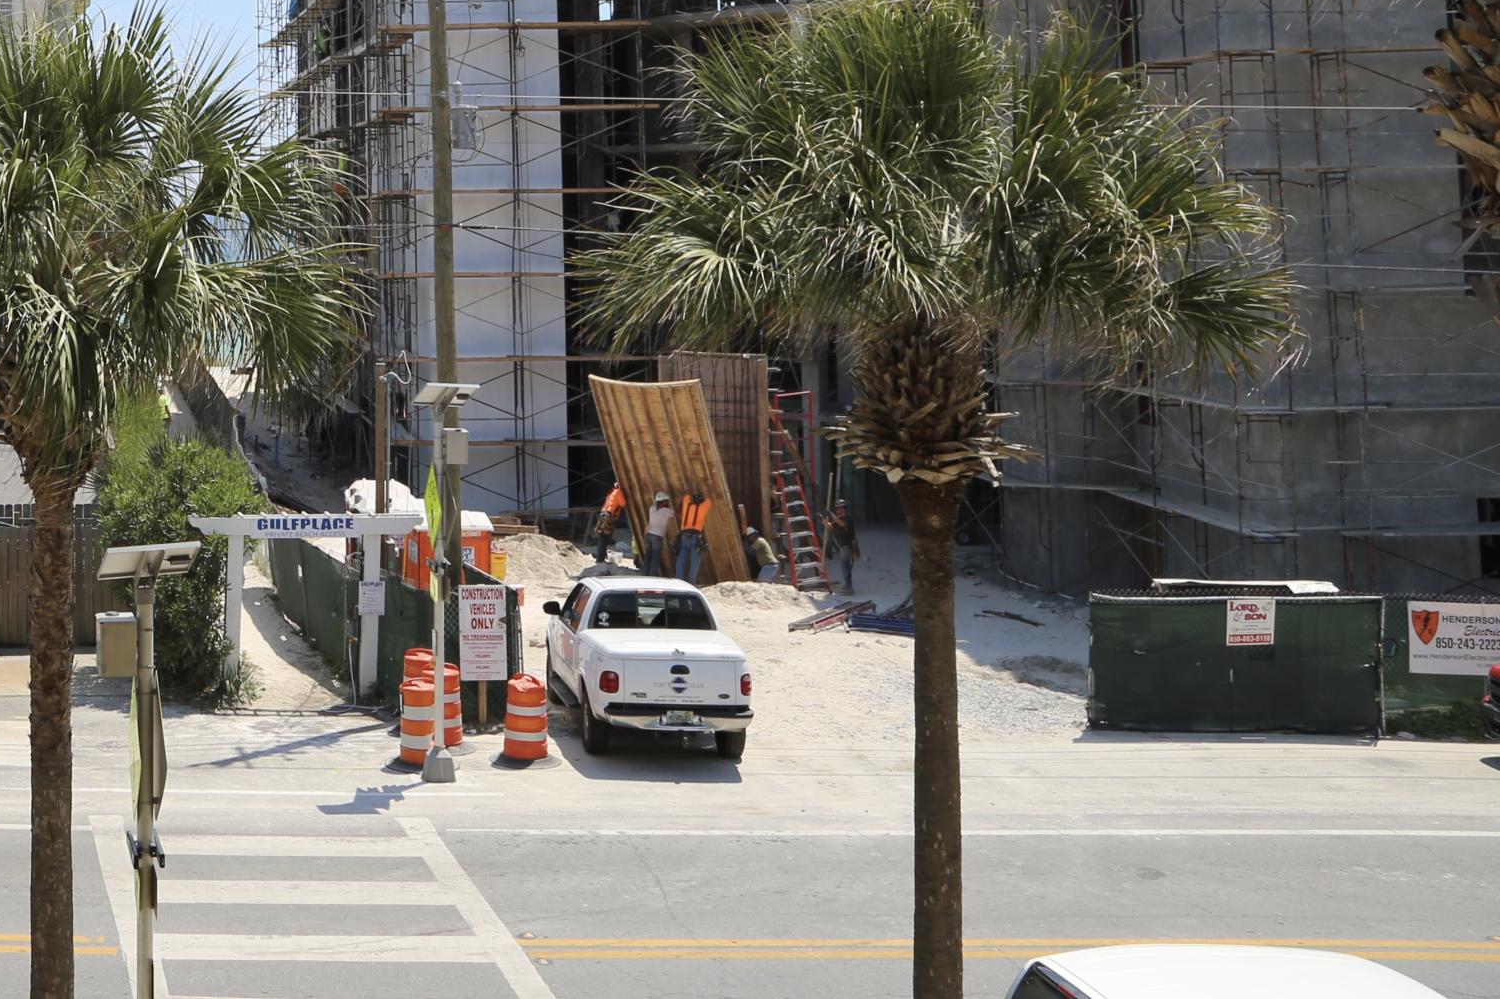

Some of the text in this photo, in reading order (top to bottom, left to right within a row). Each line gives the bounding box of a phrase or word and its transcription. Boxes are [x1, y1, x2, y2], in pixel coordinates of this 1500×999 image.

[257, 518, 354, 531] GULFPLACE
[461, 588, 504, 600] CONSTRUCTION
[469, 603, 496, 615] VEHICLES
[471, 617, 495, 629] ONLY
[1442, 615, 1500, 625] HENDERSON
[1463, 625, 1500, 637] Electric
[1435, 637, 1500, 651] 850-243-2223
